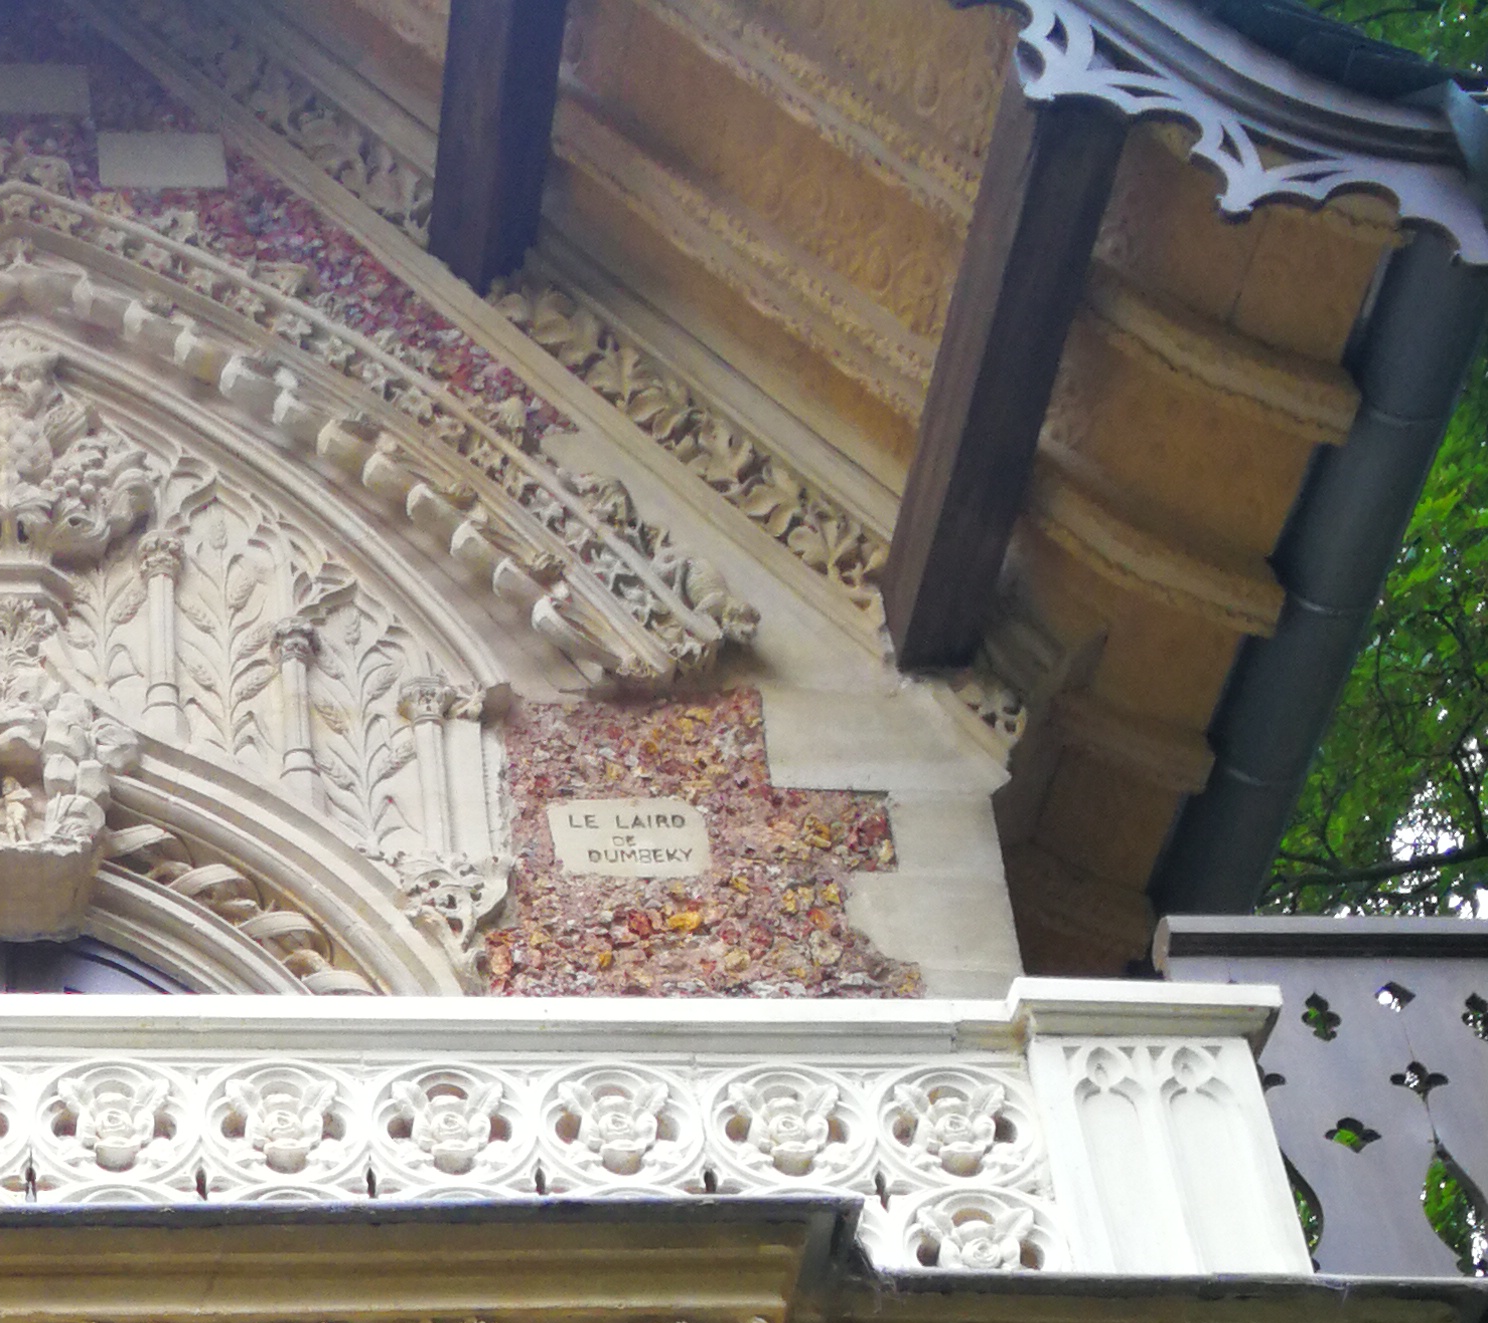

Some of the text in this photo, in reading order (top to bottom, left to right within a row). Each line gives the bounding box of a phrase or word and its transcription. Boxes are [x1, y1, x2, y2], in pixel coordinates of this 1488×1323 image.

[568, 813, 686, 830] LE LAIRD
[612, 835, 636, 848] DE
